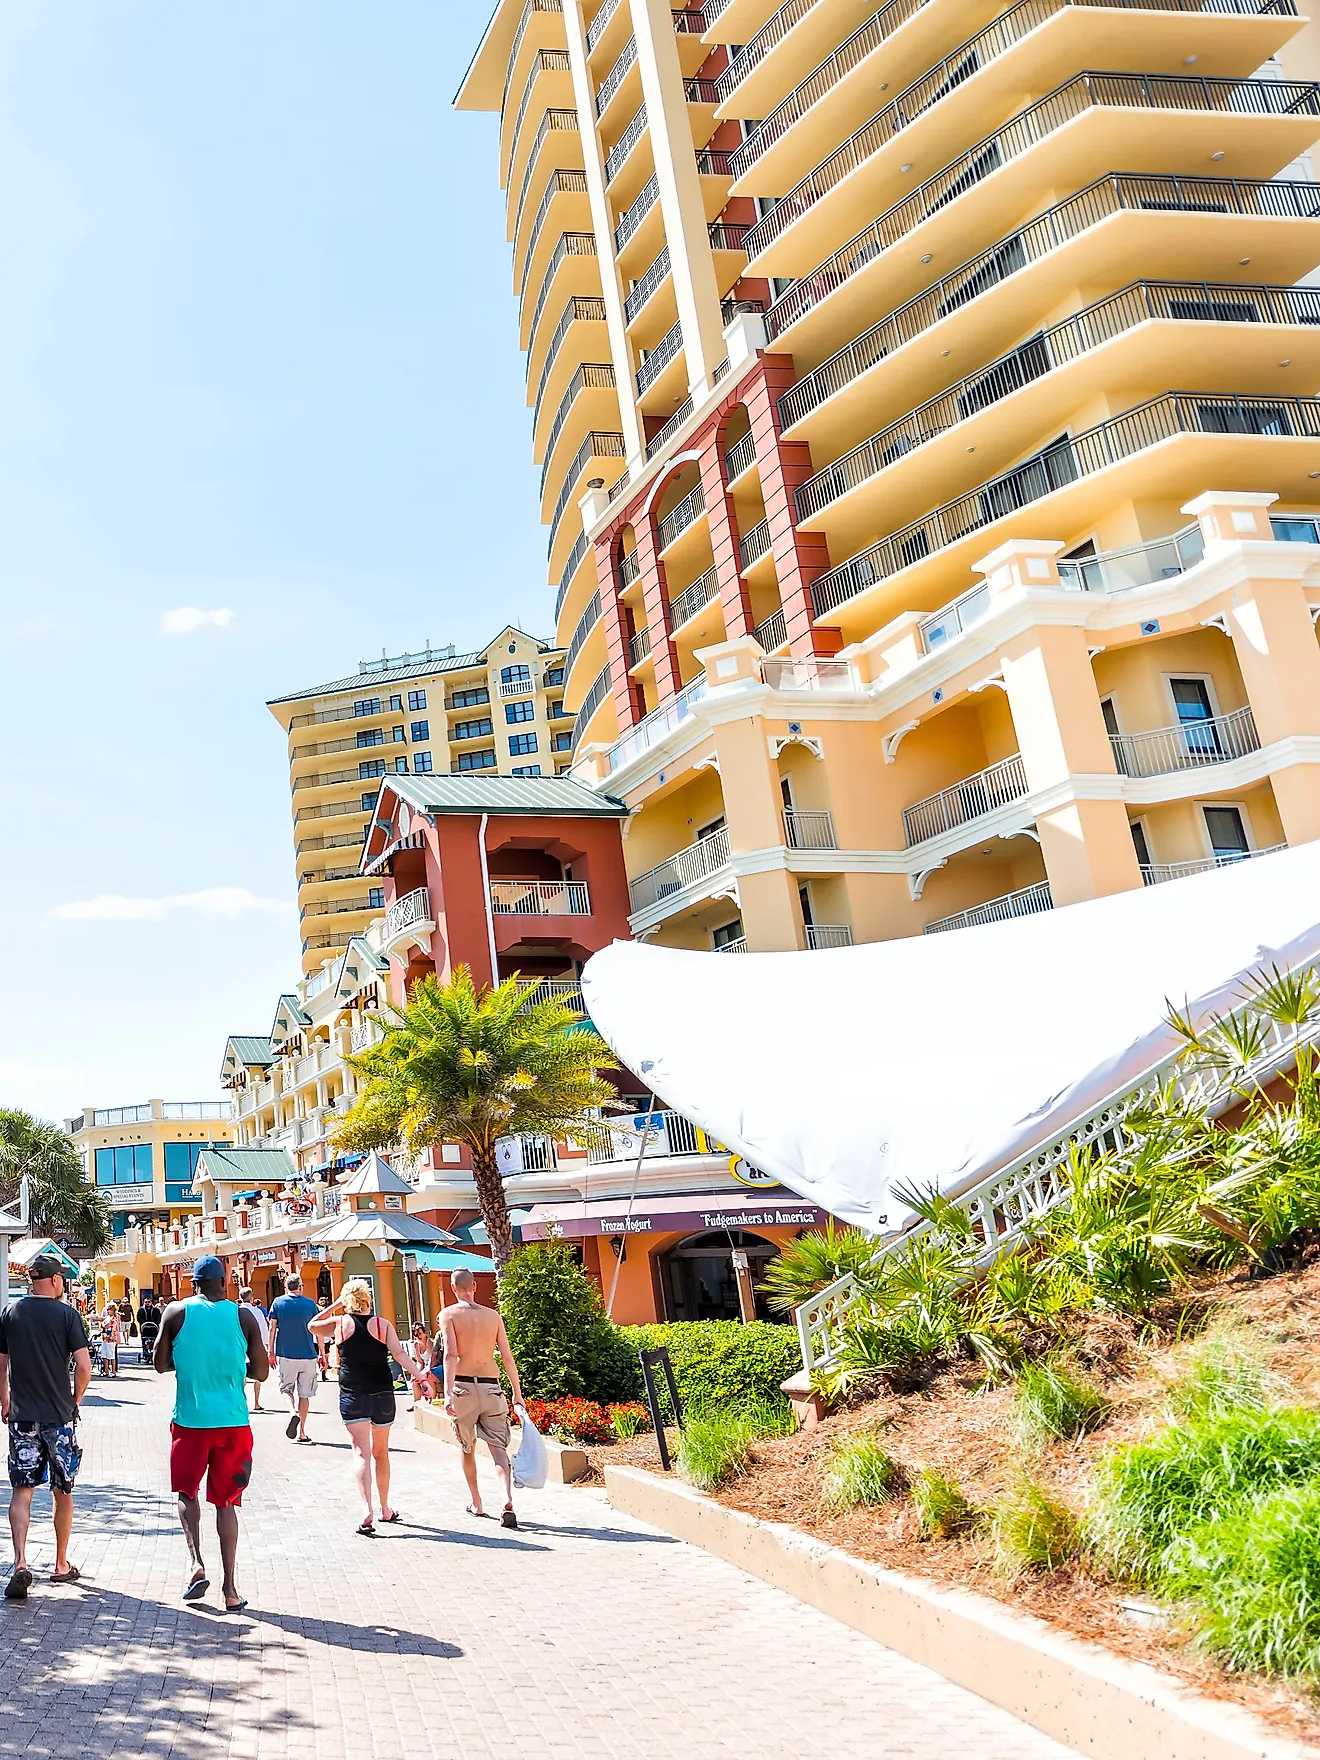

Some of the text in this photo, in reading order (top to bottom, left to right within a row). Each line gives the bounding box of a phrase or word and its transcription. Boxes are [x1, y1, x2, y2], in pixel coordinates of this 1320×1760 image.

[600, 1218, 652, 1233] Frozen Yogurt
[700, 1209, 818, 1228] "Fudgemakers to America"
